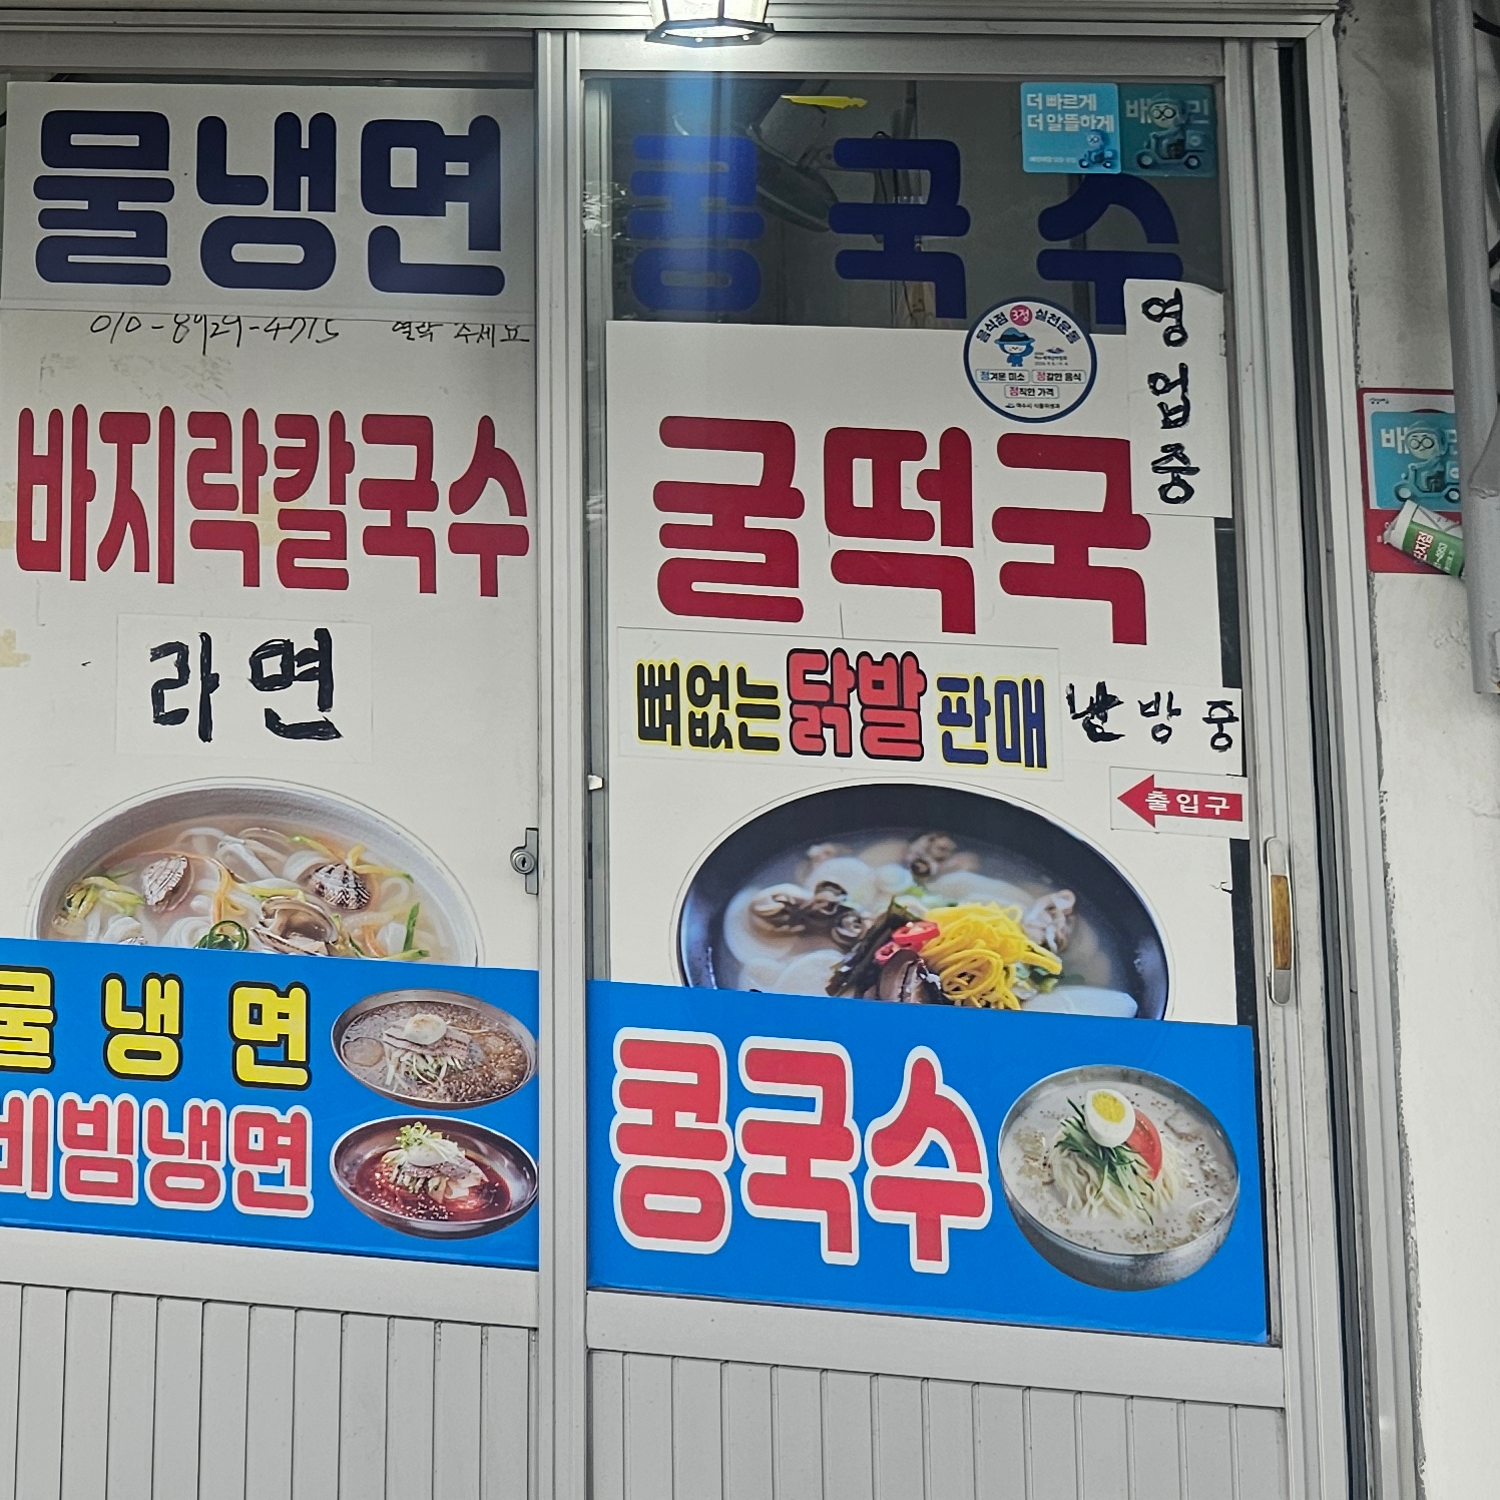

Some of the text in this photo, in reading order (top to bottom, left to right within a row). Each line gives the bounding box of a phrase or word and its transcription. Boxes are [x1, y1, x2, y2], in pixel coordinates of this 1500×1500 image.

[1026, 92, 1097, 112] 더 빠르게
[1027, 112, 1115, 133] 더 알뜰하게
[33, 109, 506, 296] 물냉면
[975, 307, 1082, 344] 음식점 3정 실천운동
[15, 403, 531, 598] 바지락칼국수
[652, 414, 1152, 647] 굴떡국
[149, 626, 343, 744] 라면
[636, 646, 1050, 770] 뼈없는 닭발 판매
[1144, 790, 1231, 816] 출입구
[609, 1025, 993, 1275] 콩국수
